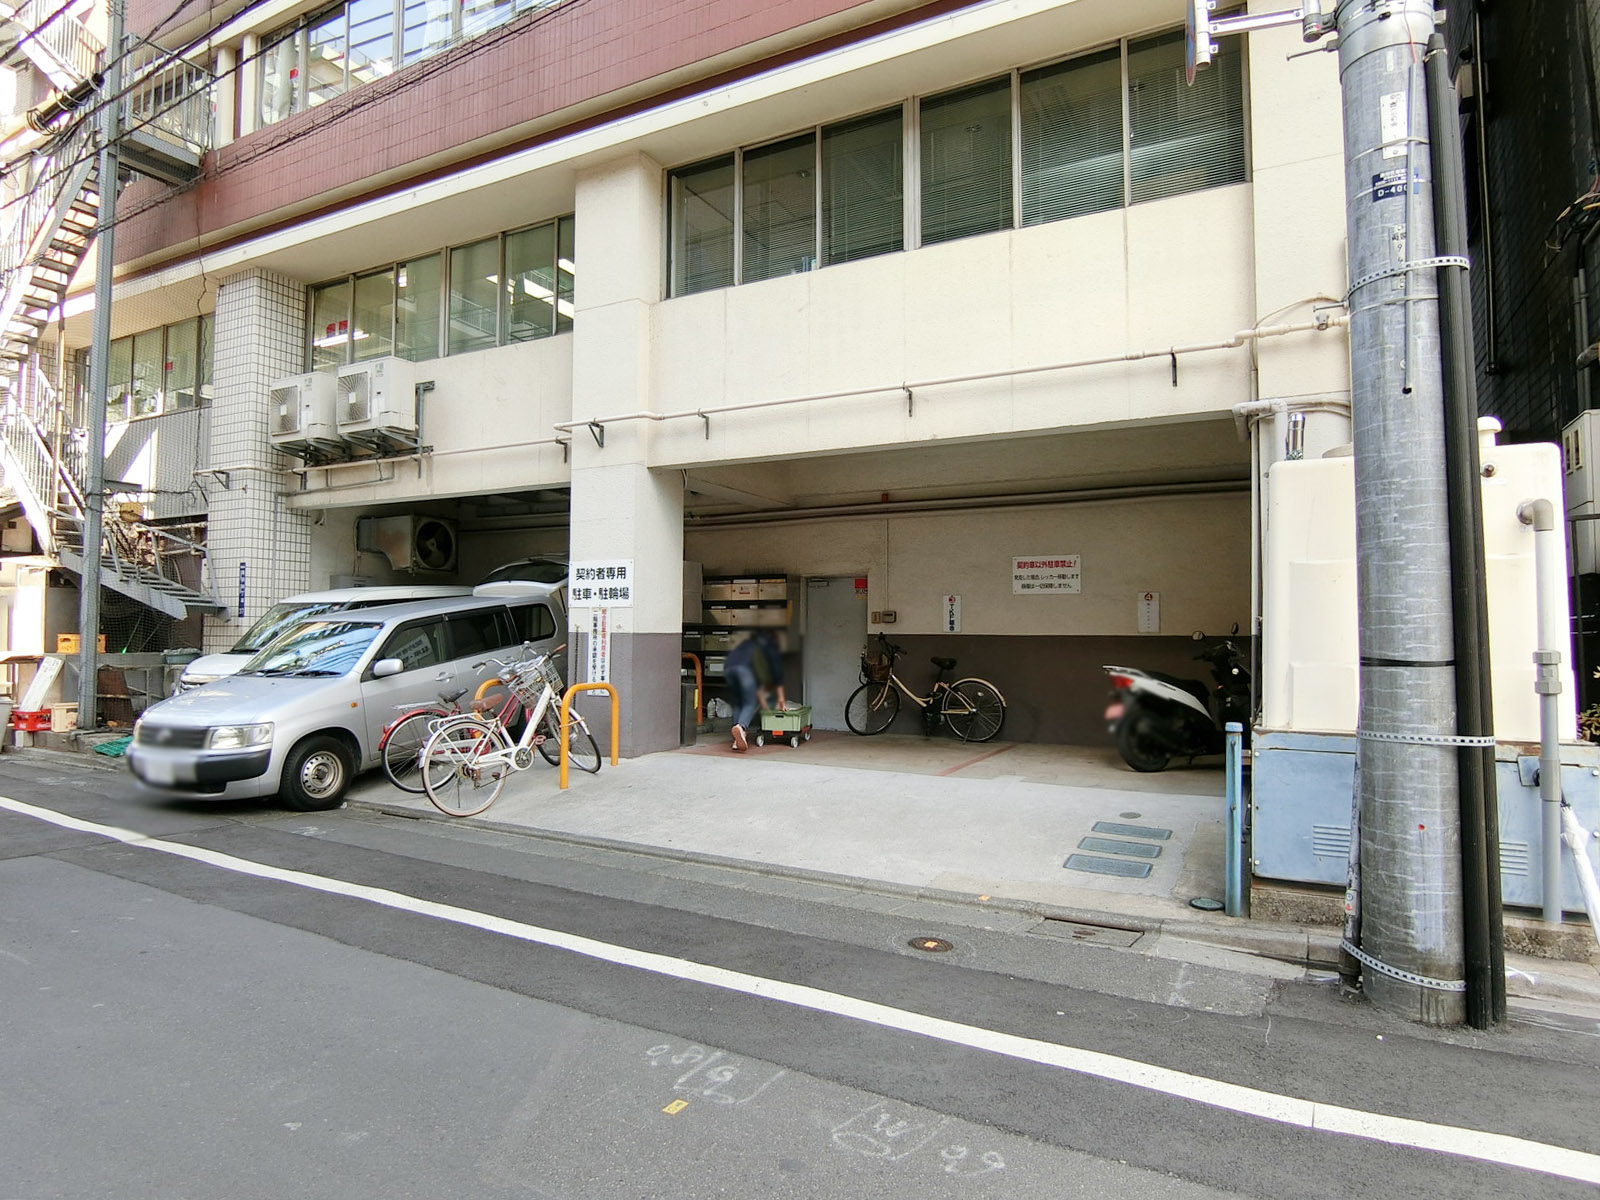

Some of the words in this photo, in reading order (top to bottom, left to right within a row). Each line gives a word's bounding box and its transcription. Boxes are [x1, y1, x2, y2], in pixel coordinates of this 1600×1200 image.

[576, 567, 626, 580] 契約者専用
[572, 587, 629, 600] 駐車・駐輪場
